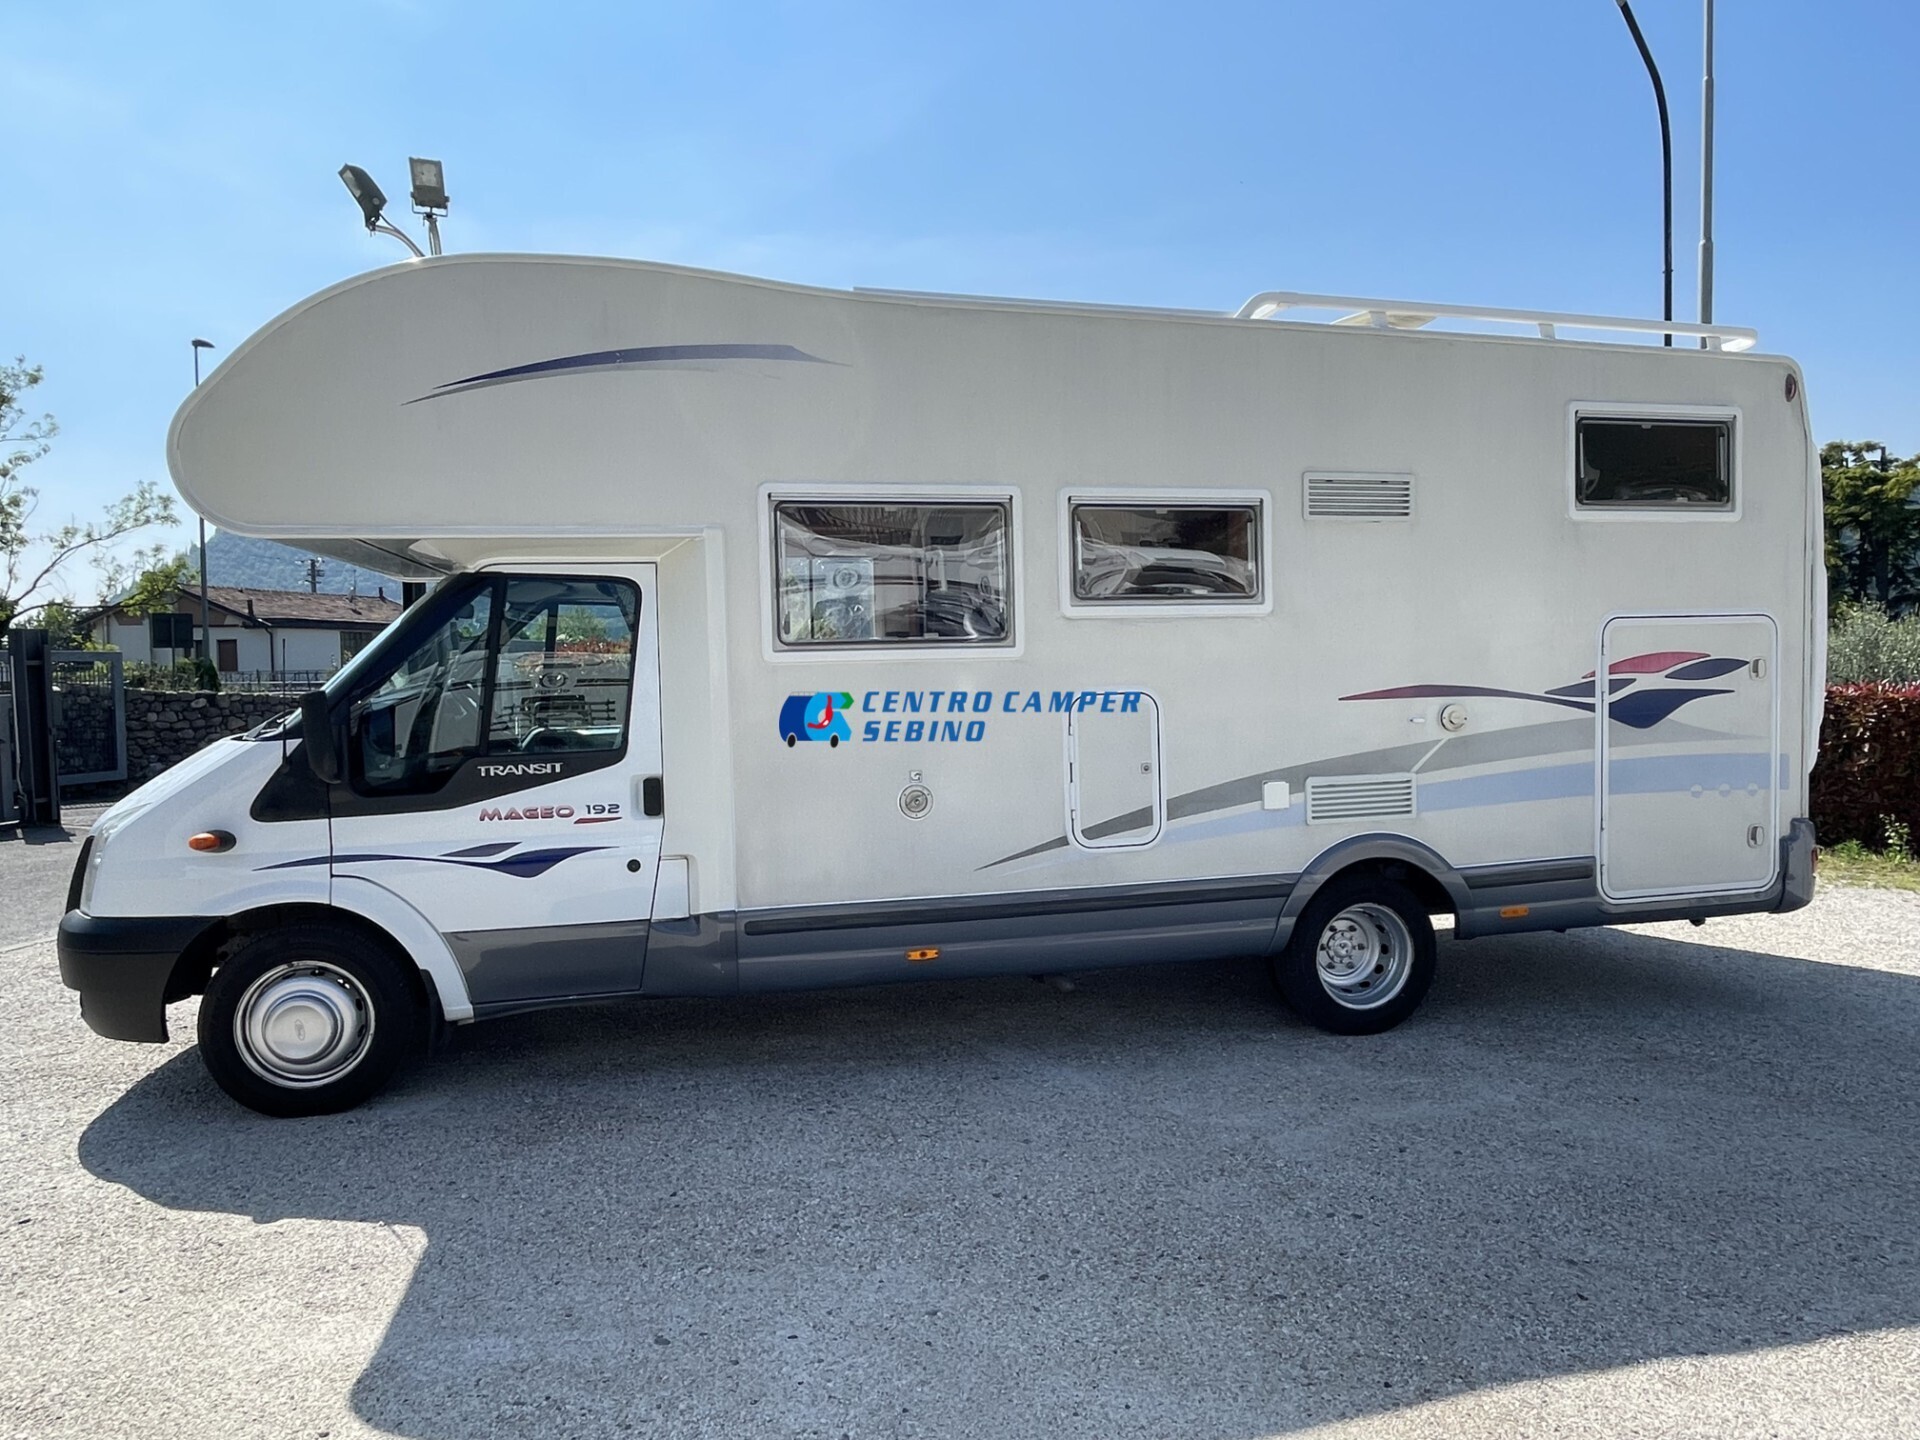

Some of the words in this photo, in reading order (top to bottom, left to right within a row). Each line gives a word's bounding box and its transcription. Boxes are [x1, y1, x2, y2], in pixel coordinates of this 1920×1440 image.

[477, 763, 563, 777] TRANSIT
[479, 805, 575, 821] MAGEO
[586, 804, 621, 814] 192
